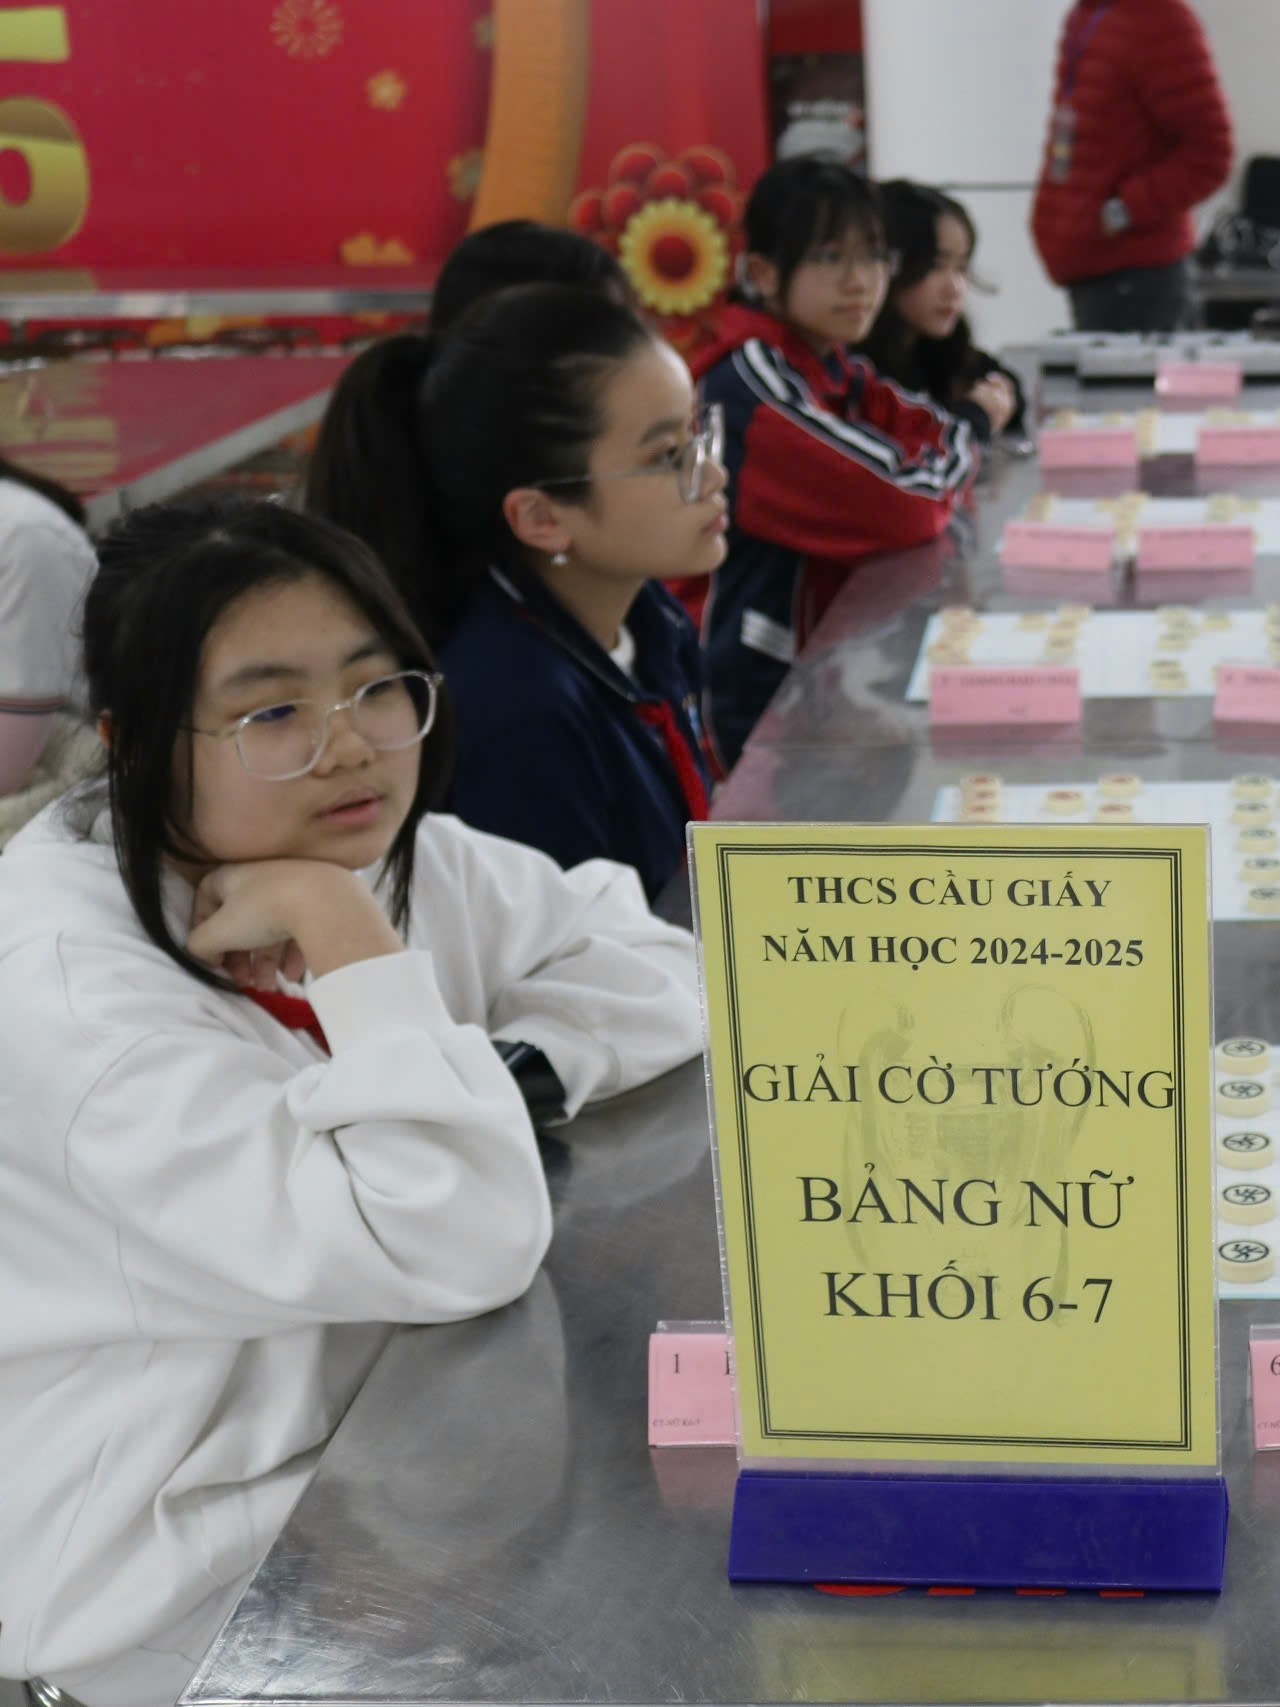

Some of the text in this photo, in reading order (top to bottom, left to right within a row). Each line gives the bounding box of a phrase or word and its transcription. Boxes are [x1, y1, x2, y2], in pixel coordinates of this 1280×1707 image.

[787, 869, 1112, 907] THCS CẦU GIẤY
[761, 927, 1144, 971] NĂM HỌC 2024-2025
[743, 1053, 1176, 1110] GIẢI CỜ TƯỚNG
[795, 1162, 1135, 1230] BẢNG NỮ
[821, 1259, 1113, 1324] KHỐI 6-7
